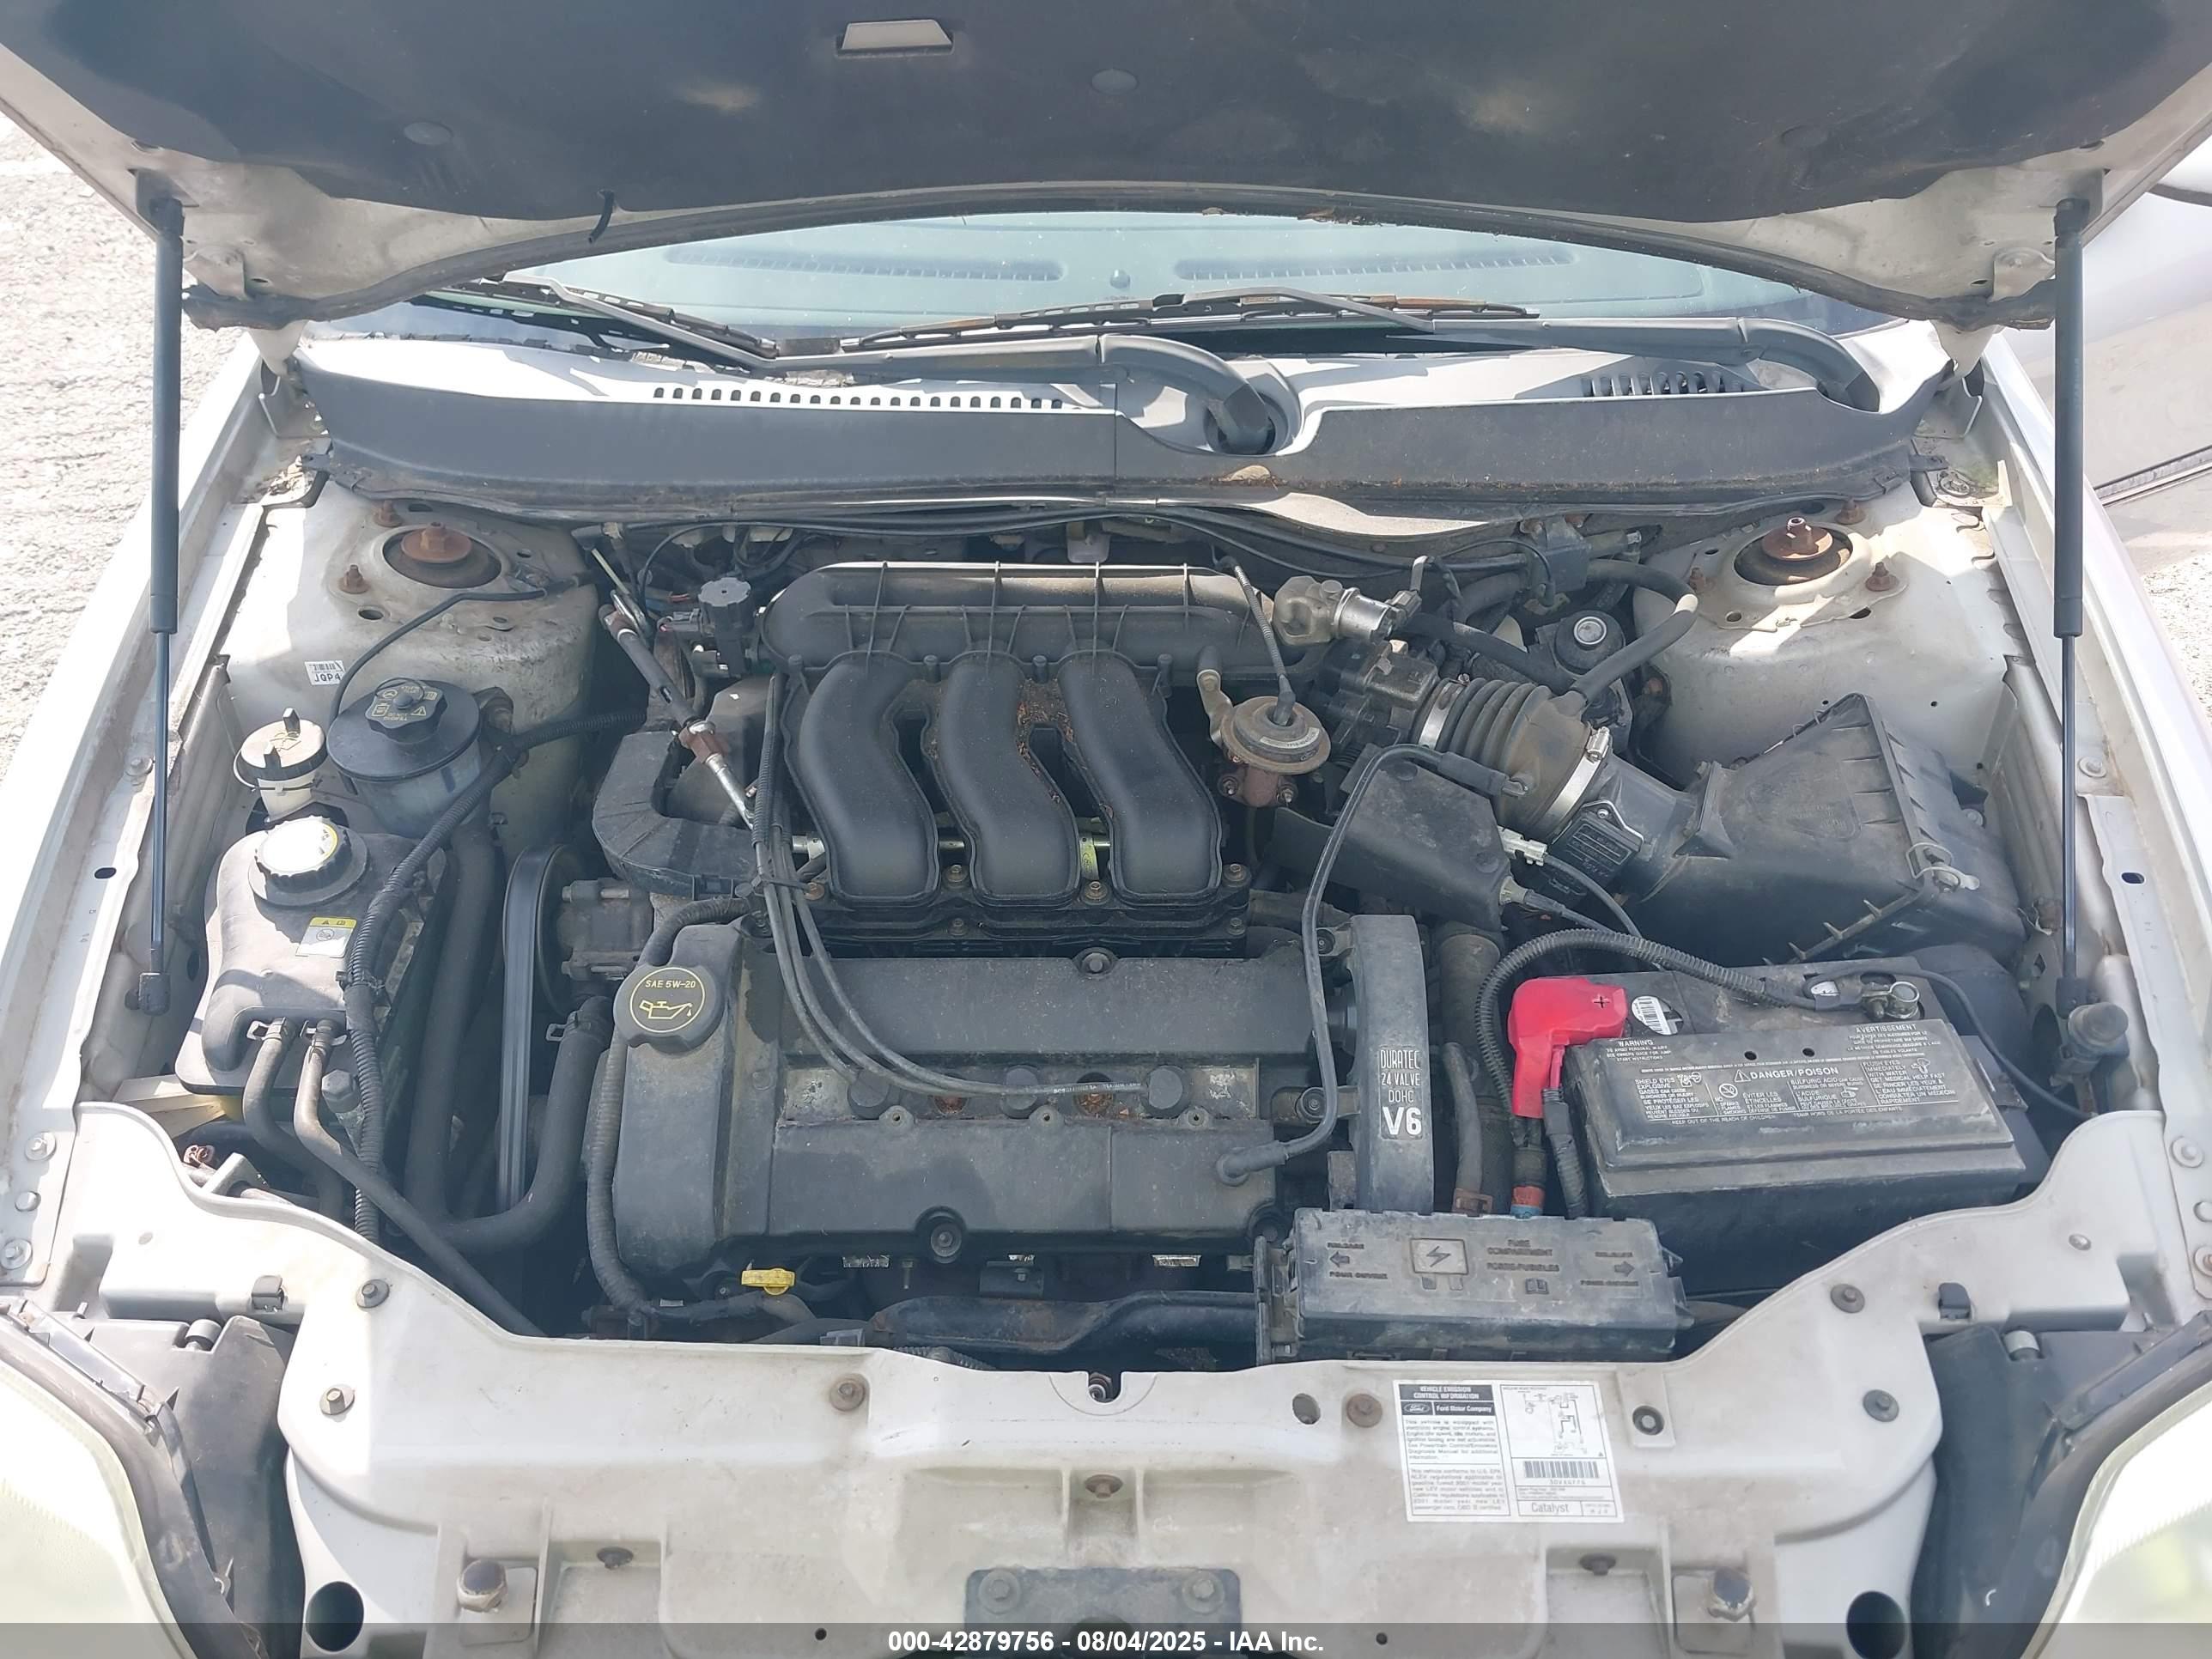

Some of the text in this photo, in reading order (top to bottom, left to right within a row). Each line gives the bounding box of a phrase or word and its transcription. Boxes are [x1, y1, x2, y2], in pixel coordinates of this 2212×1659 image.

[1381, 1050, 1420, 1069] DURATEC
[1382, 1073, 1420, 1085] 24 VALVE
[1750, 1067, 1838, 1079] DANGER/POISON
[1389, 1091, 1413, 1103] DOHC
[1382, 1107, 1421, 1135] V6
[1532, 1504, 1569, 1515] Catalyst
